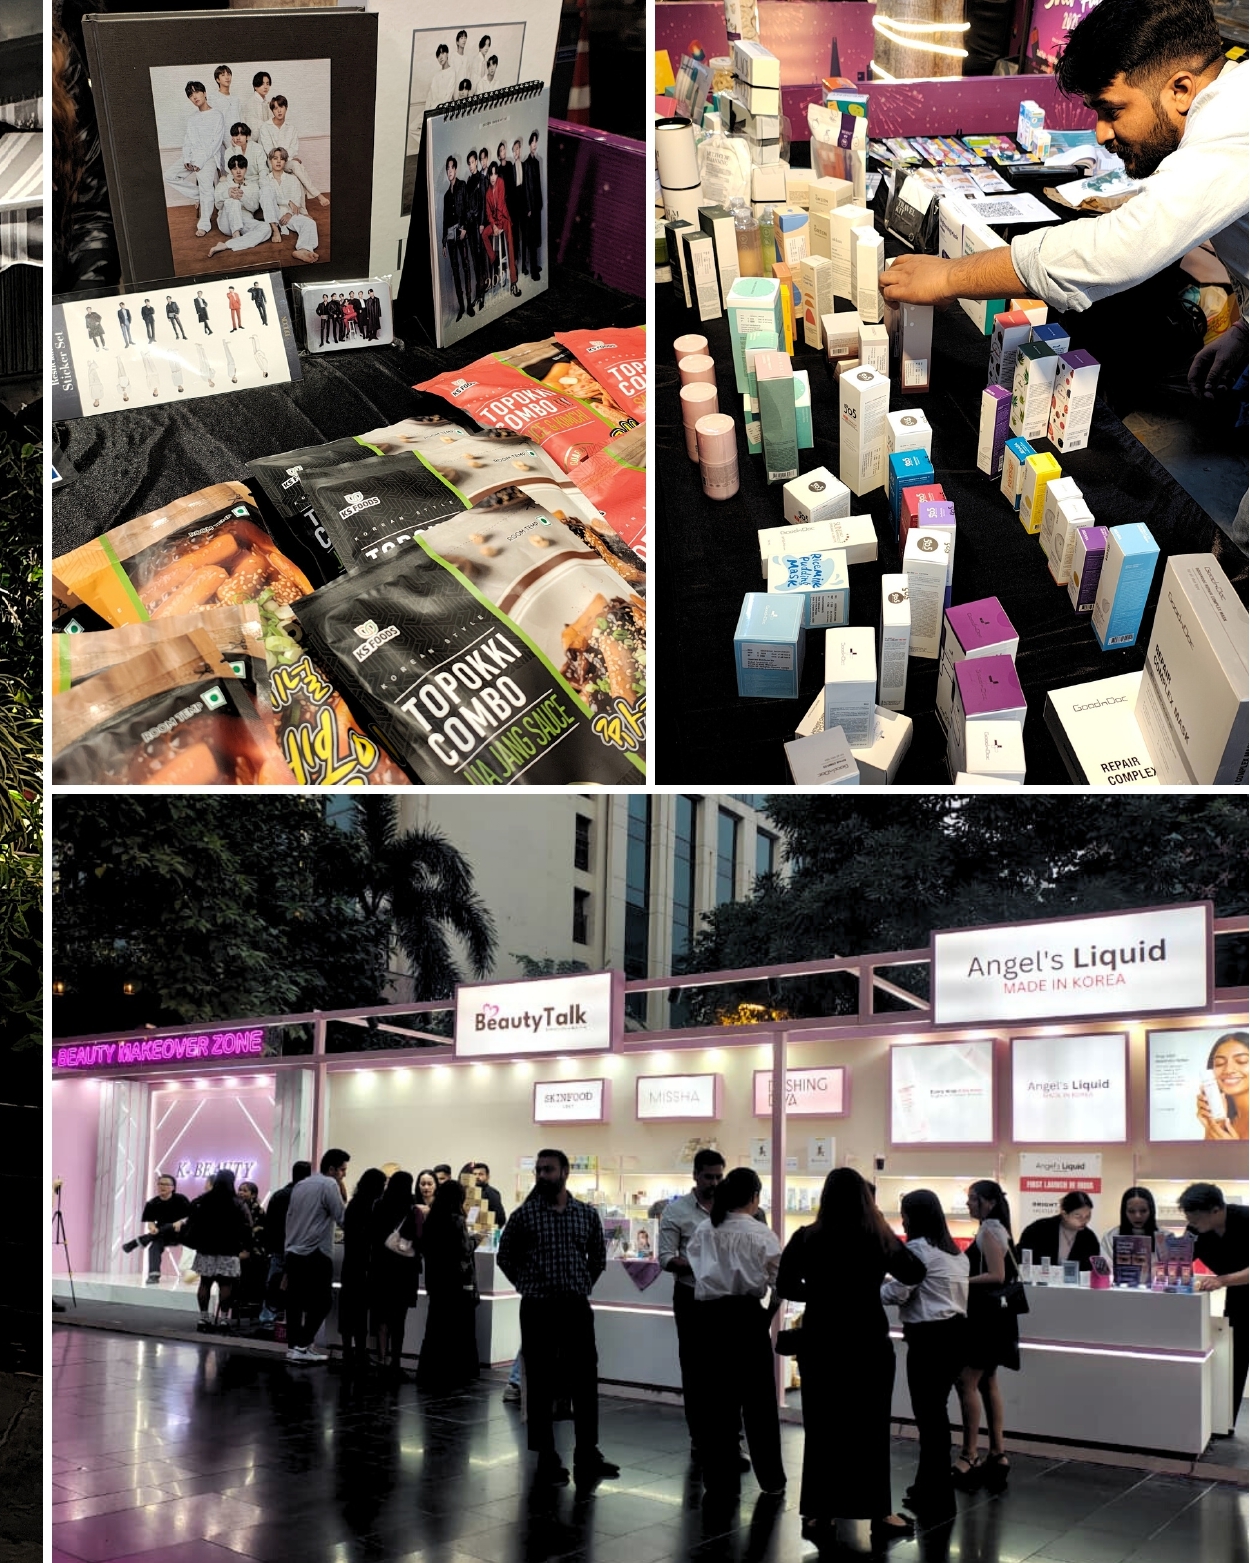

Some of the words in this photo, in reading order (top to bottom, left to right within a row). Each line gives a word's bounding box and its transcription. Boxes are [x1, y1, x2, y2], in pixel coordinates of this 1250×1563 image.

[54, 331, 66, 349] Set
[60, 351, 74, 391] Sticker
[556, 409, 592, 428] KIMCHI
[340, 508, 352, 520] KS
[352, 497, 380, 515] FOODS
[354, 515, 404, 542] KOREAN
[507, 526, 524, 543] ROOM
[523, 520, 539, 534] TEMP
[786, 559, 798, 588] Mask
[798, 556, 812, 587] Pudding
[356, 642, 370, 660] KS
[369, 626, 398, 649] FOODS
[381, 648, 434, 690] KOREAN
[444, 614, 485, 644] STYLE
[1155, 643, 1172, 684] REPAIR
[401, 632, 523, 732] TOPOKKI
[1073, 694, 1129, 713] GoodnDoc
[1153, 654, 1174, 709] COMPLEX
[1173, 706, 1191, 746] MASK
[141, 715, 175, 743] ROOM
[174, 701, 204, 727] TEMP
[427, 675, 527, 767] COMBO
[489, 725, 538, 778] JANG
[522, 693, 576, 746] SAUCE
[1100, 756, 1141, 773] REPAIR
[967, 951, 1064, 980] Angel's
[1074, 938, 1166, 970] Liquid
[1004, 979, 1047, 994] MADE
[1052, 978, 1067, 991] IN
[1073, 974, 1126, 989] KOREA
[475, 1004, 587, 1033] BeautyTalk
[58, 1044, 116, 1067] BEAUTY
[118, 1037, 210, 1063] MAKEOVER
[211, 1030, 263, 1053] ZONE
[544, 1091, 593, 1104] SKINFOOD
[649, 1091, 700, 1104] MISSHA
[1028, 1081, 1069, 1093] Angel's
[1072, 1079, 1110, 1091] Liquid
[1036, 1162, 1060, 1171] Angel's
[1062, 1161, 1086, 1171] Liquid
